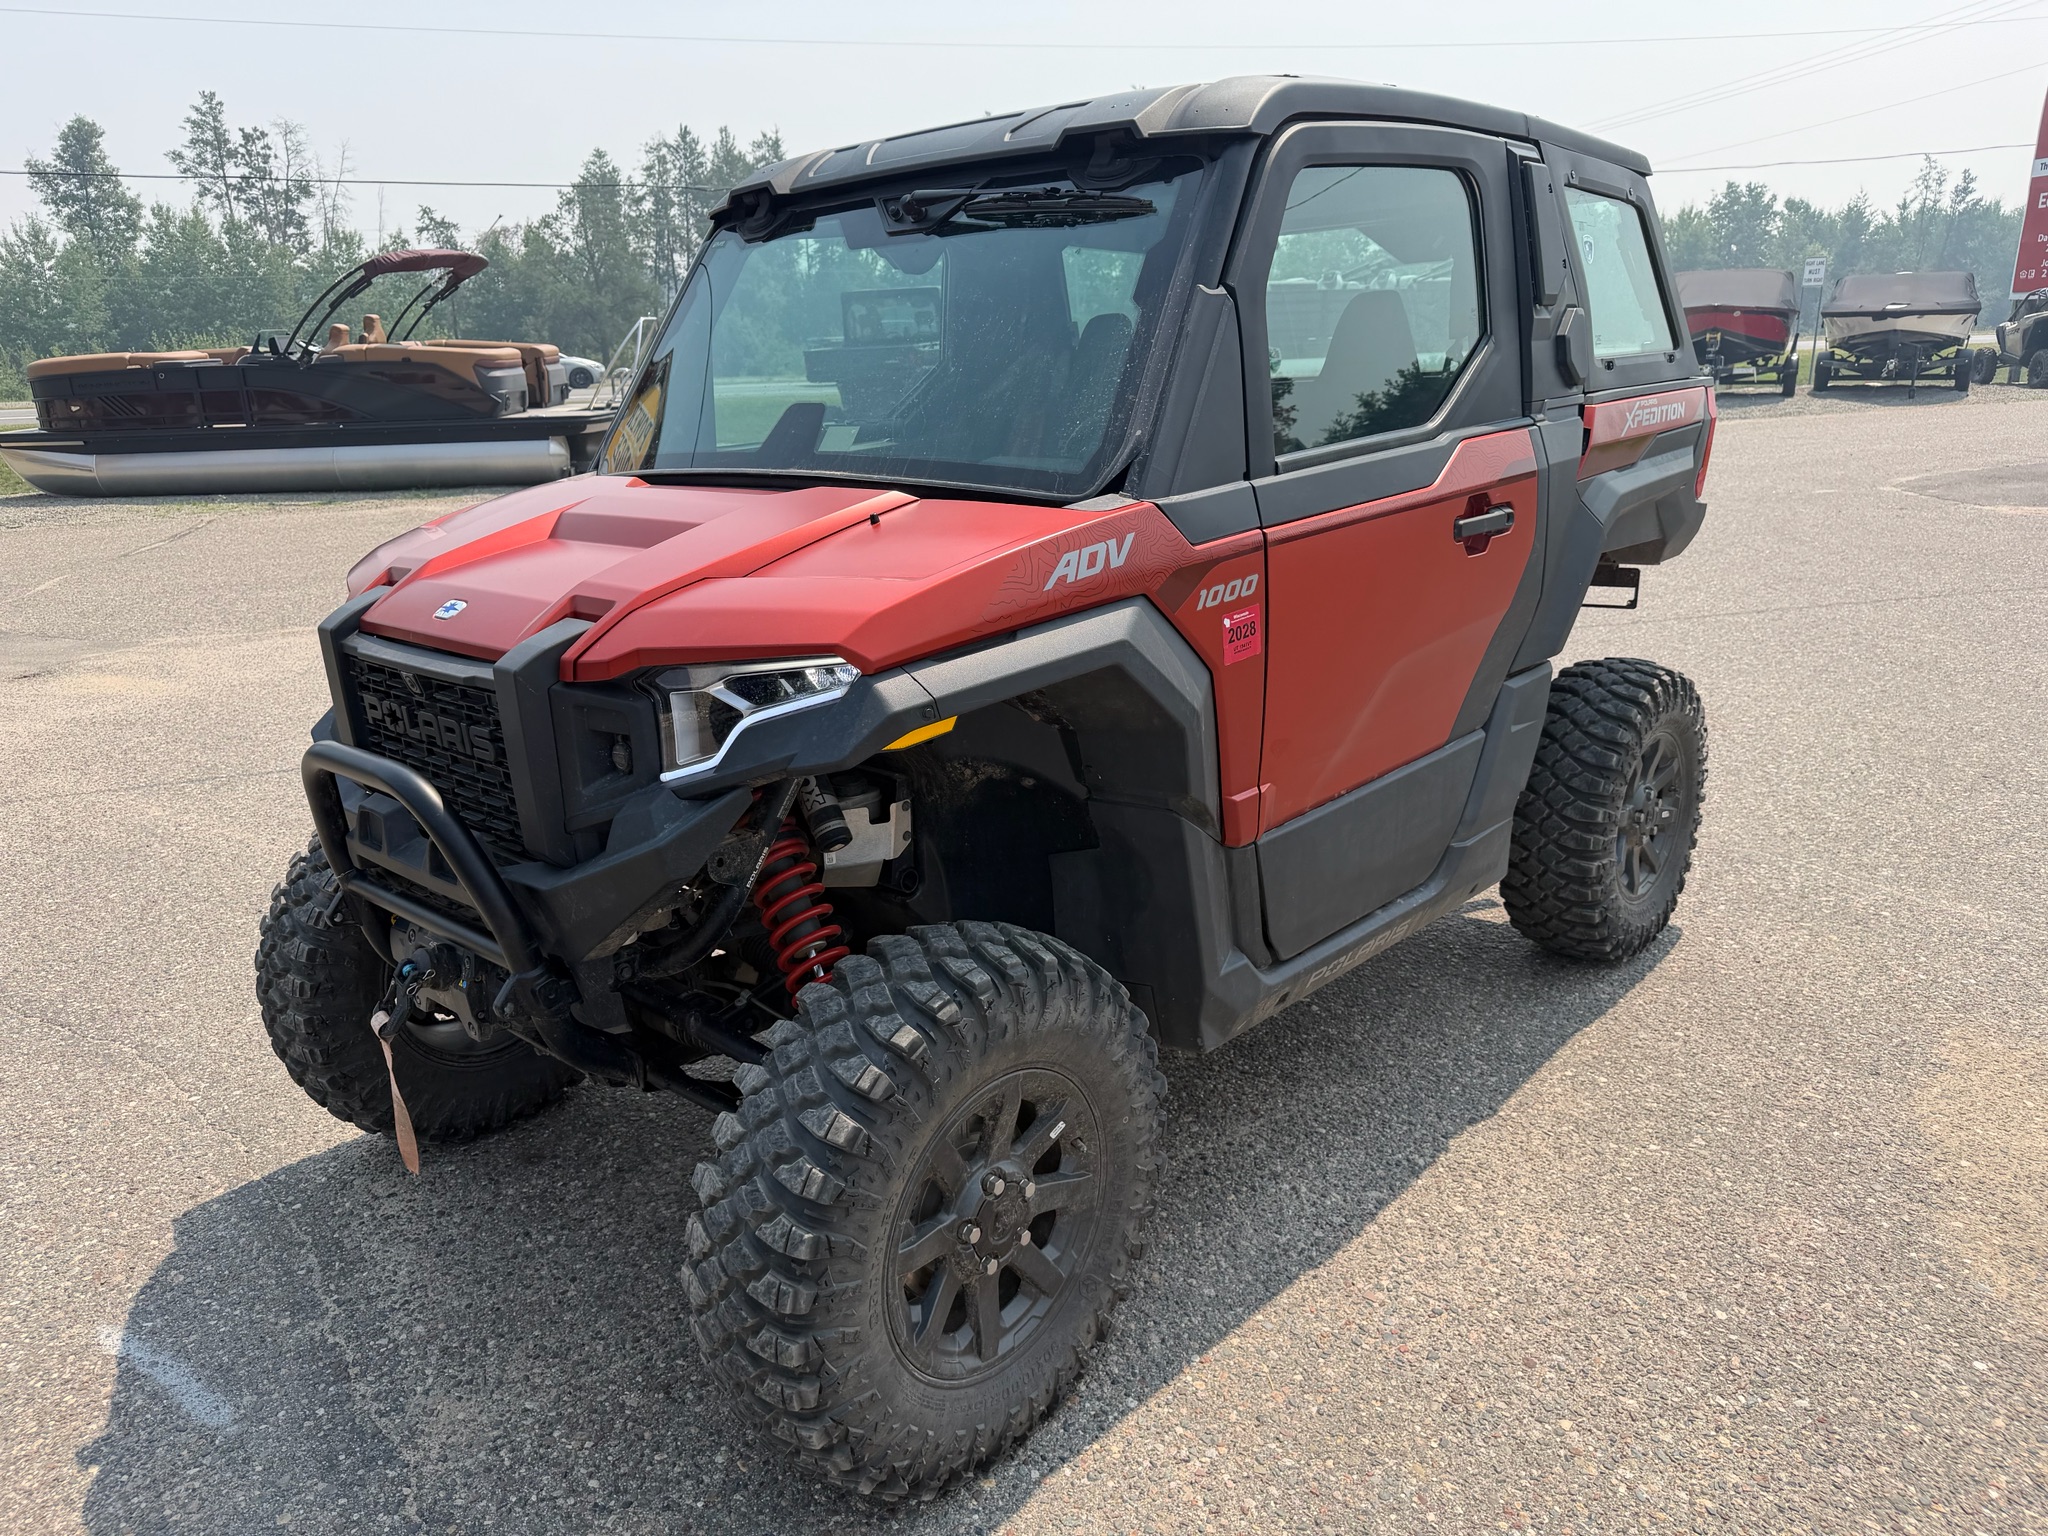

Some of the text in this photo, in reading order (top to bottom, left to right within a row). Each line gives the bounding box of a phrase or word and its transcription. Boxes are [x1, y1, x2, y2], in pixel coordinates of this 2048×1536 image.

[2040, 162, 2048, 171] Th
[2038, 192, 2048, 209] E
[2038, 233, 2048, 242] Da
[1621, 401, 1685, 437] XPEDITION
[1641, 398, 1658, 407] POLARIS
[1043, 532, 1136, 592] ADV
[1196, 573, 1259, 611] 1000
[1228, 621, 1256, 644] 2028
[364, 695, 495, 762] POLARIS
[746, 846, 769, 889] POLARIS
[1306, 918, 1412, 988] POLARIS
